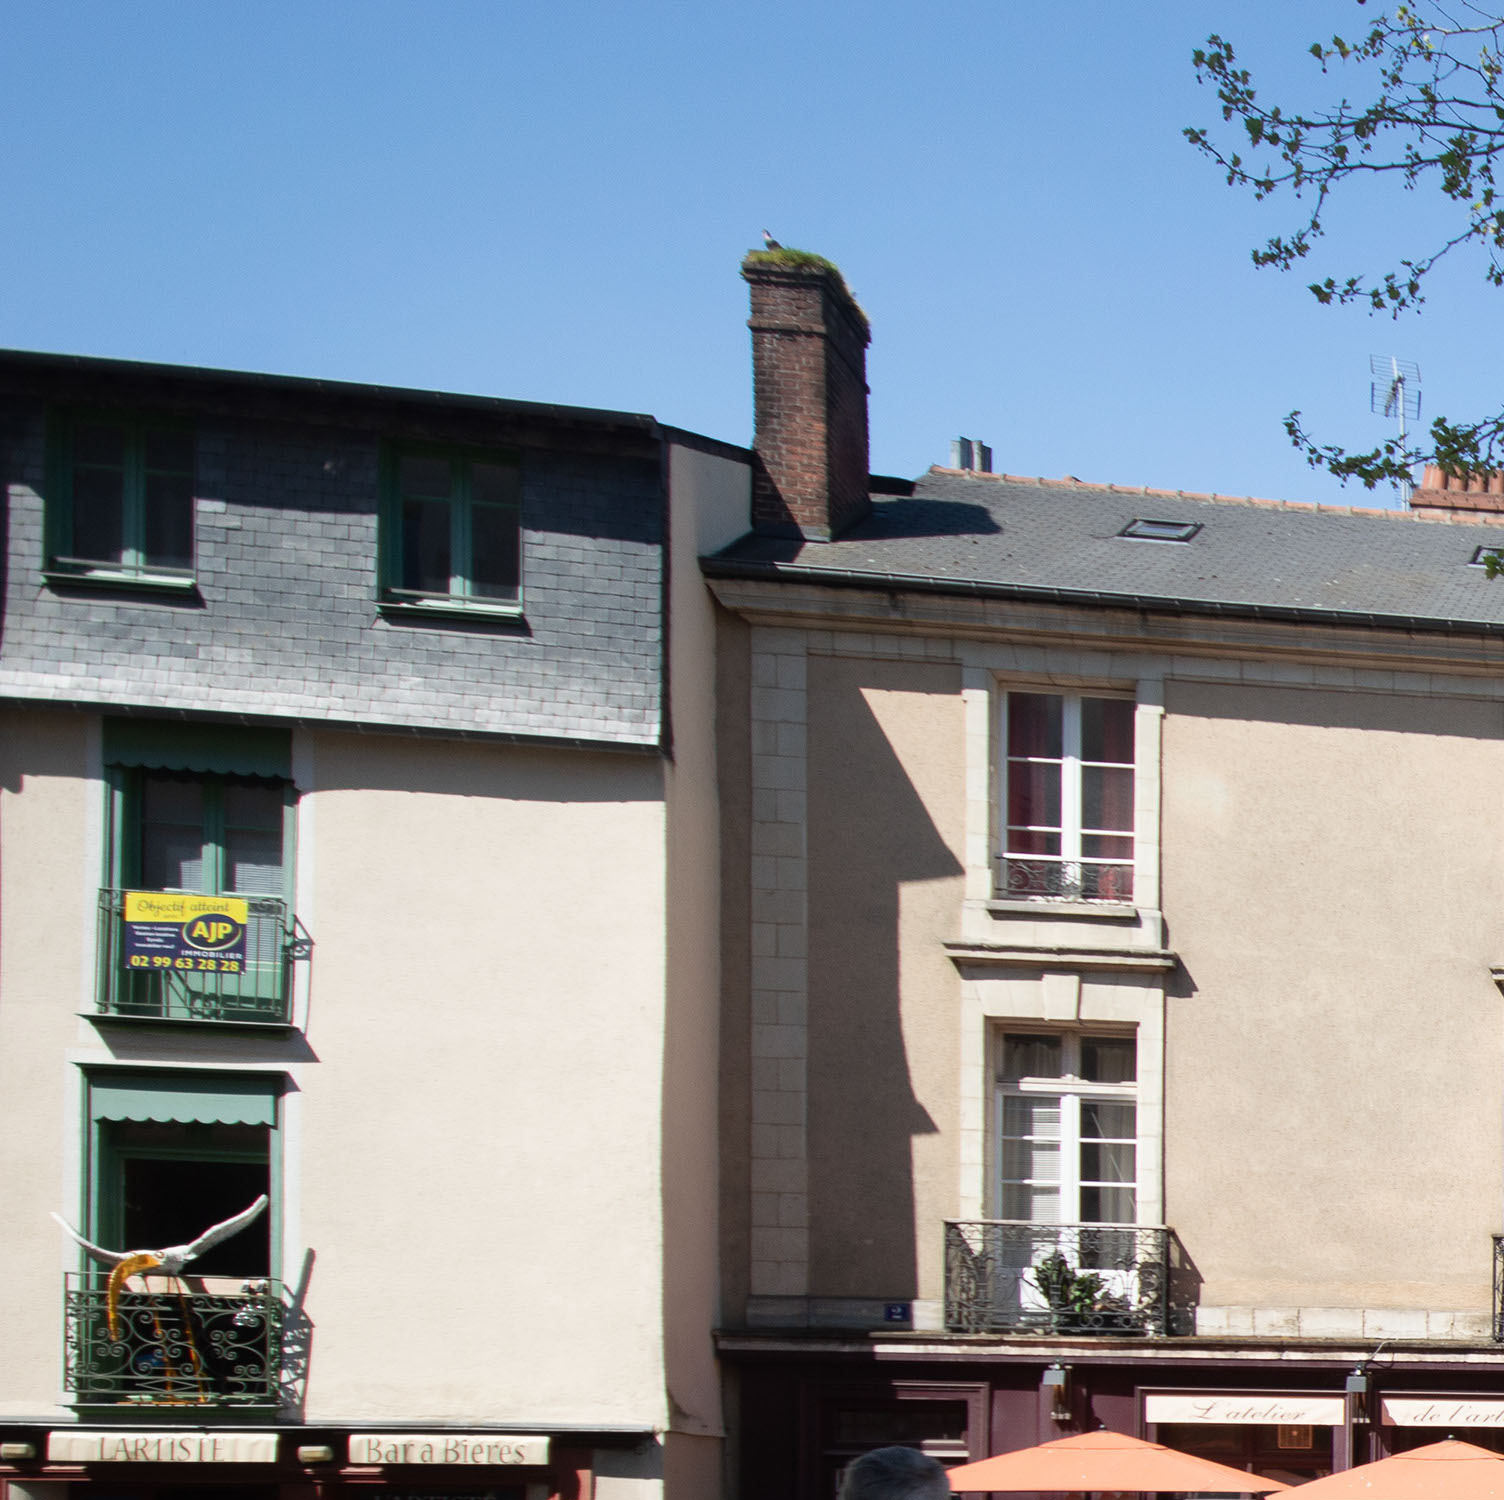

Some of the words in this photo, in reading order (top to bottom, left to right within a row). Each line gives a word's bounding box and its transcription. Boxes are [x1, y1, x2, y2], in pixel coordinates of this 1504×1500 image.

[190, 900, 230, 912] atteint
[191, 920, 233, 943] AJP
[130, 955, 149, 967] 02
[152, 956, 172, 968] 99
[175, 957, 194, 969] 63
[197, 958, 216, 970] 28
[220, 960, 240, 972] 28
[180, 949, 243, 960] IMMOBILIER
[1413, 1403, 1440, 1422] de
[366, 1438, 415, 1463] Bar
